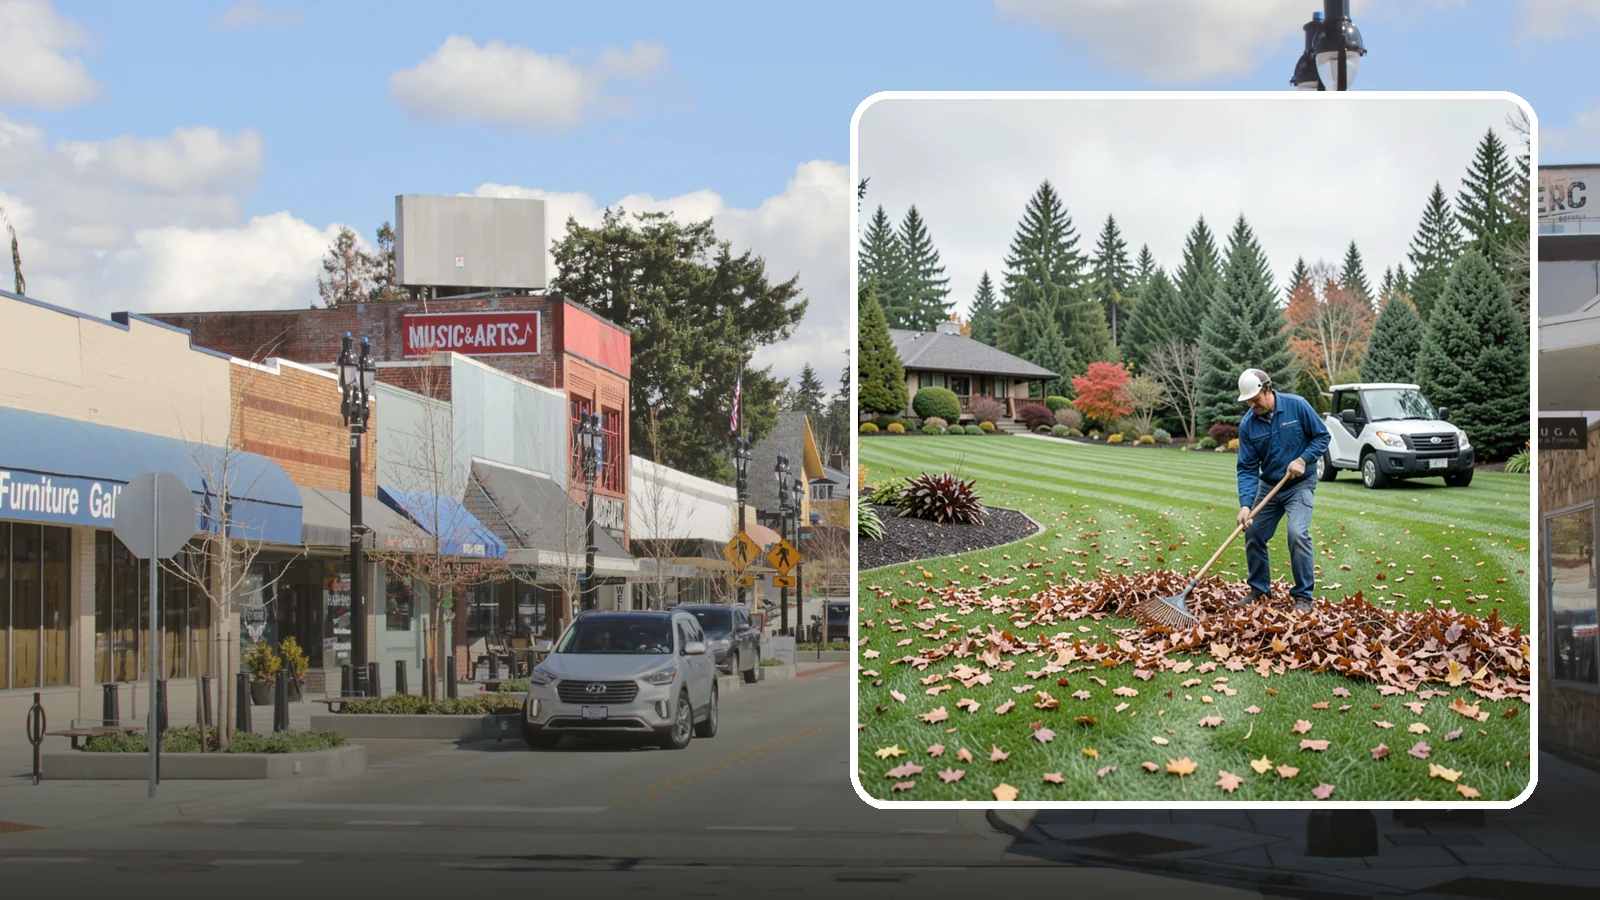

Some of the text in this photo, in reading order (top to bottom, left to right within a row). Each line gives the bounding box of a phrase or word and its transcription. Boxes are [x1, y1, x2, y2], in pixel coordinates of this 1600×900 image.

[0, 472, 121, 518] Furniture Gal
[454, 563, 480, 574] SUSHI
